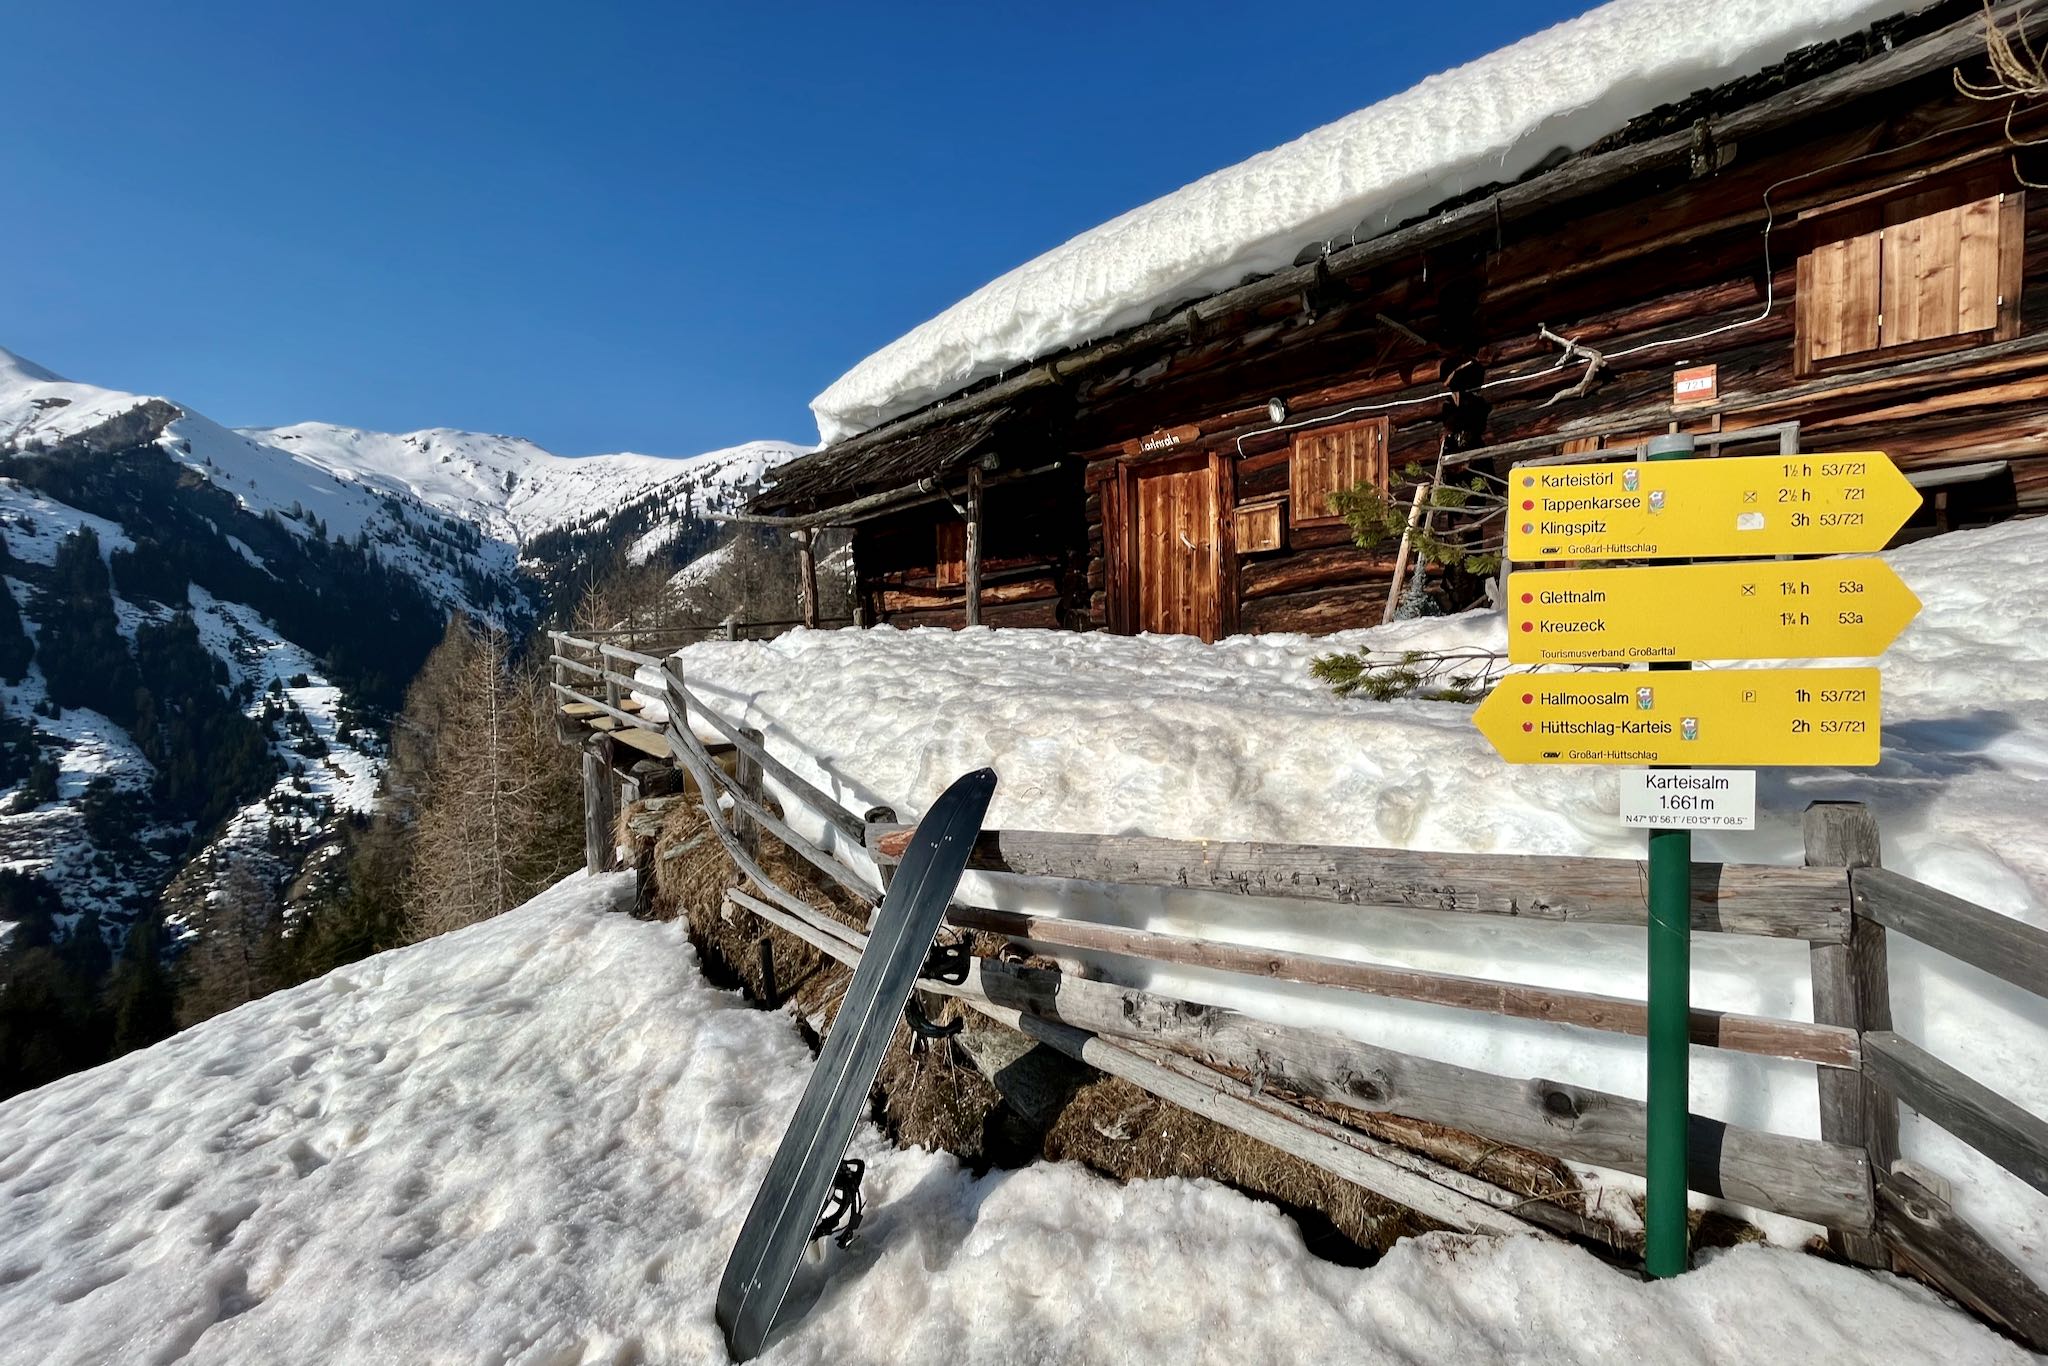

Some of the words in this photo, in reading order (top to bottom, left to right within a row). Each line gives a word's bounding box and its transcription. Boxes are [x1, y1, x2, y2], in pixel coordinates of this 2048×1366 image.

[1802, 464, 1811, 476] h
[1822, 464, 1866, 476] 53/721
[1541, 472, 1613, 488] Karteistörl
[1801, 489, 1811, 502] h
[1844, 488, 1865, 500] 721
[1541, 496, 1641, 512] Tappenkarsee
[1820, 514, 1864, 526] 53/721
[1540, 520, 1606, 536] Klingspitz
[1568, 543, 1657, 555] Großarl-Hüttschlag
[1800, 582, 1809, 594] h
[1839, 582, 1864, 593] 53a
[1540, 590, 1606, 604] Glettnalm
[1800, 612, 1809, 625] h
[1838, 612, 1863, 624] 53a
[1540, 619, 1605, 632] Kreuzeck
[1541, 648, 1625, 658] Tourismusverband
[1628, 646, 1676, 657] Großarltal
[1541, 692, 1629, 705] Hallmoosalm
[1795, 690, 1810, 702] 1h
[1820, 690, 1866, 702] 53/721
[1541, 720, 1672, 736] Hüttschlag-Karteis
[1791, 720, 1810, 733] 2h
[1820, 721, 1866, 732] 53/721
[1568, 750, 1658, 760] Großarl-Hüttschlag
[1646, 775, 1729, 790] Karteisalm
